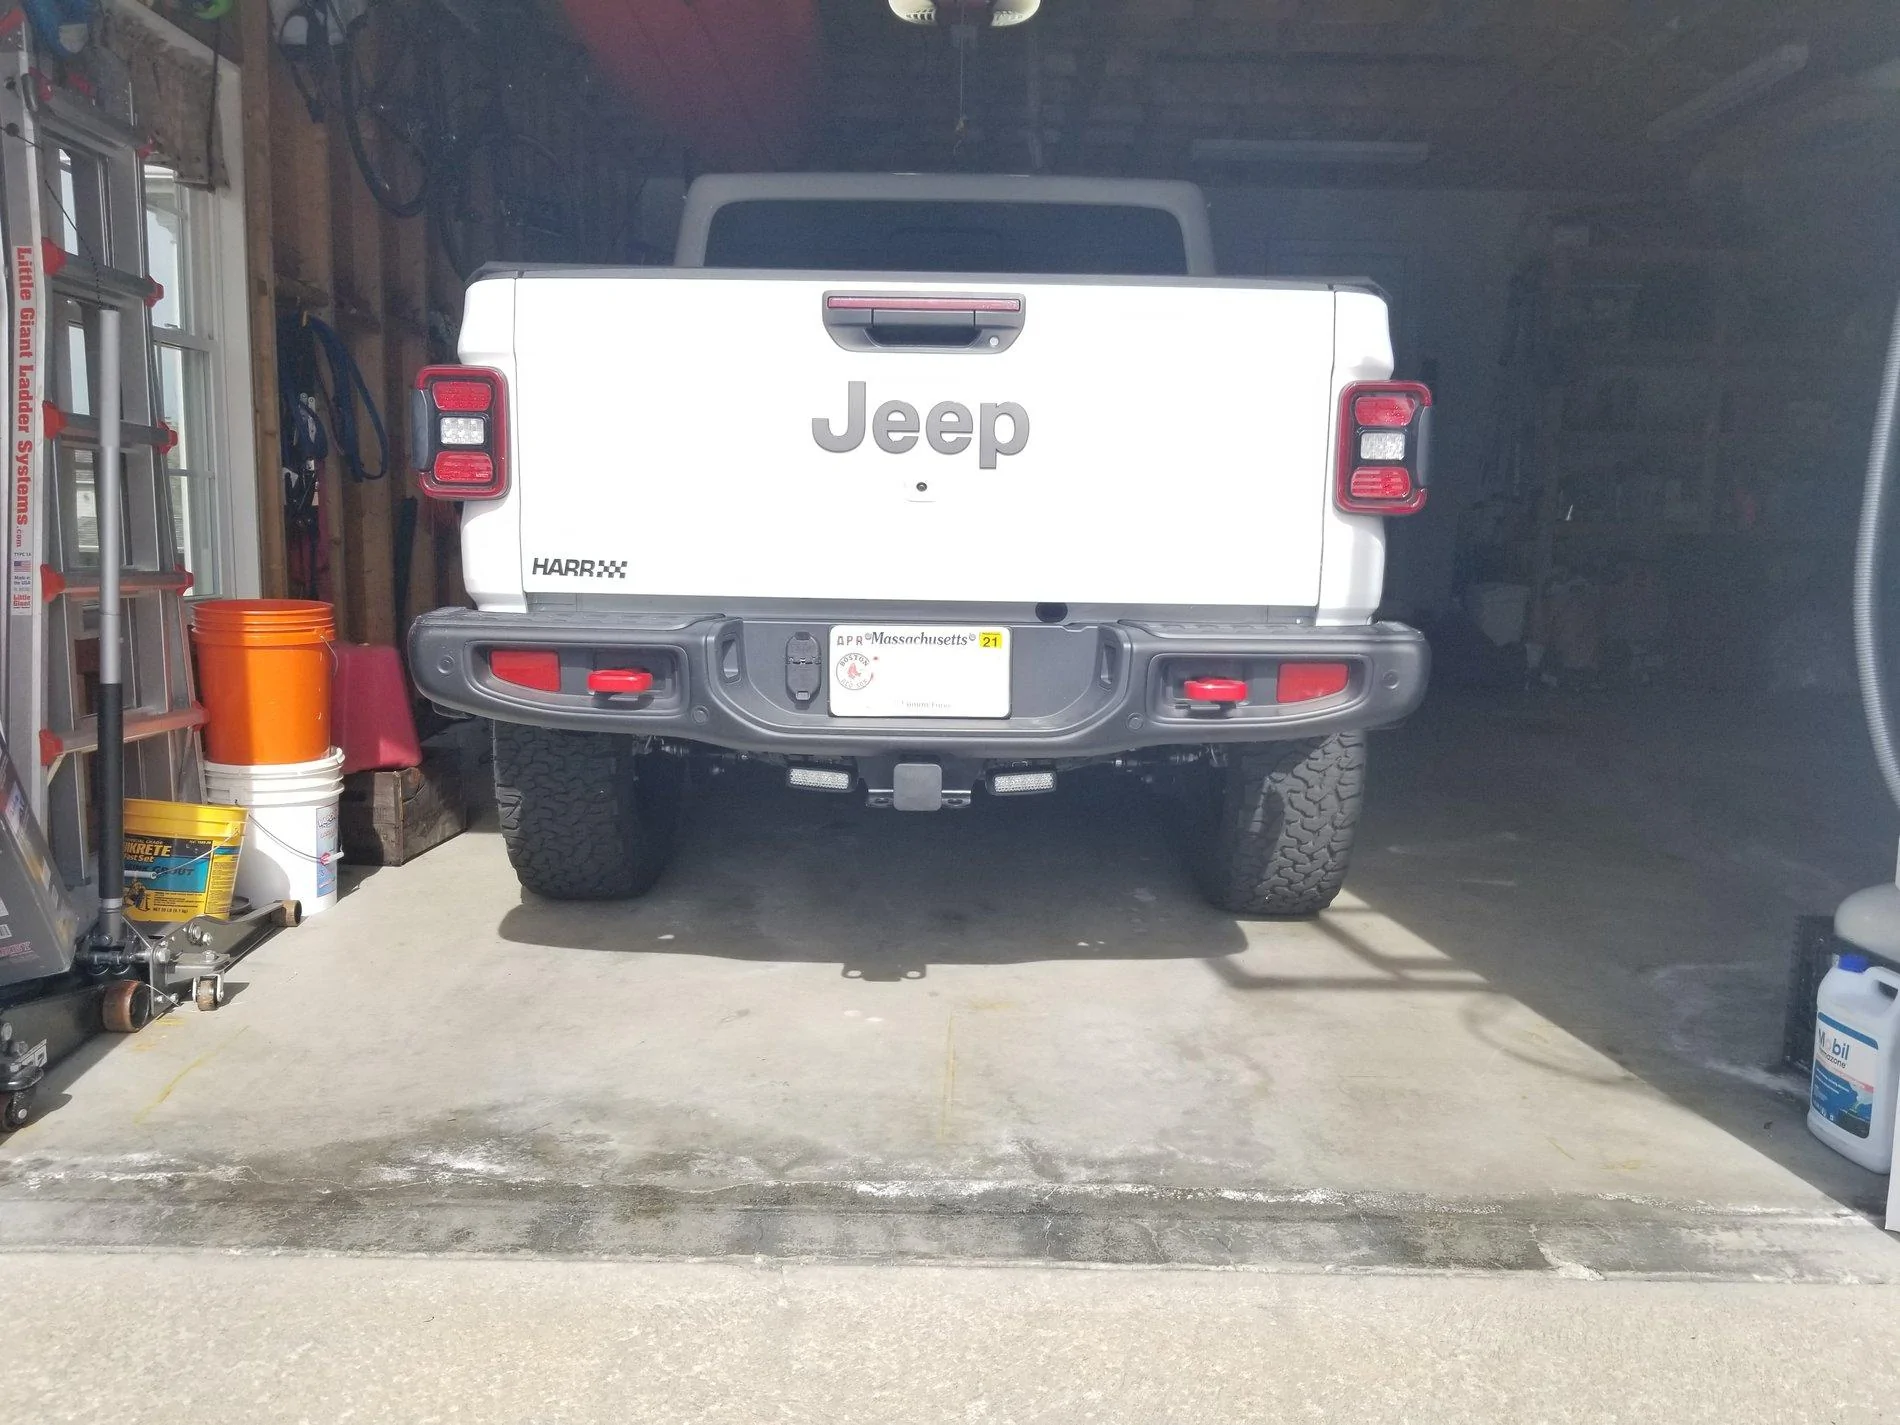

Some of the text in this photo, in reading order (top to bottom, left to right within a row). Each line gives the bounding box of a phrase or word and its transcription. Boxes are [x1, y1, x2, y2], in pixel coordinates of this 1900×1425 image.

[16, 247, 34, 301] Little
[19, 307, 35, 358] Giant
[18, 364, 34, 433] Ladder
[811, 380, 1030, 469] Jeep
[532, 557, 596, 577] HARR
[836, 635, 863, 646] APR
[871, 631, 969, 646] Massachusetts
[982, 636, 998, 648] 21
[839, 654, 869, 667] BOSTON
[1818, 1028, 1850, 1061] Mobil
